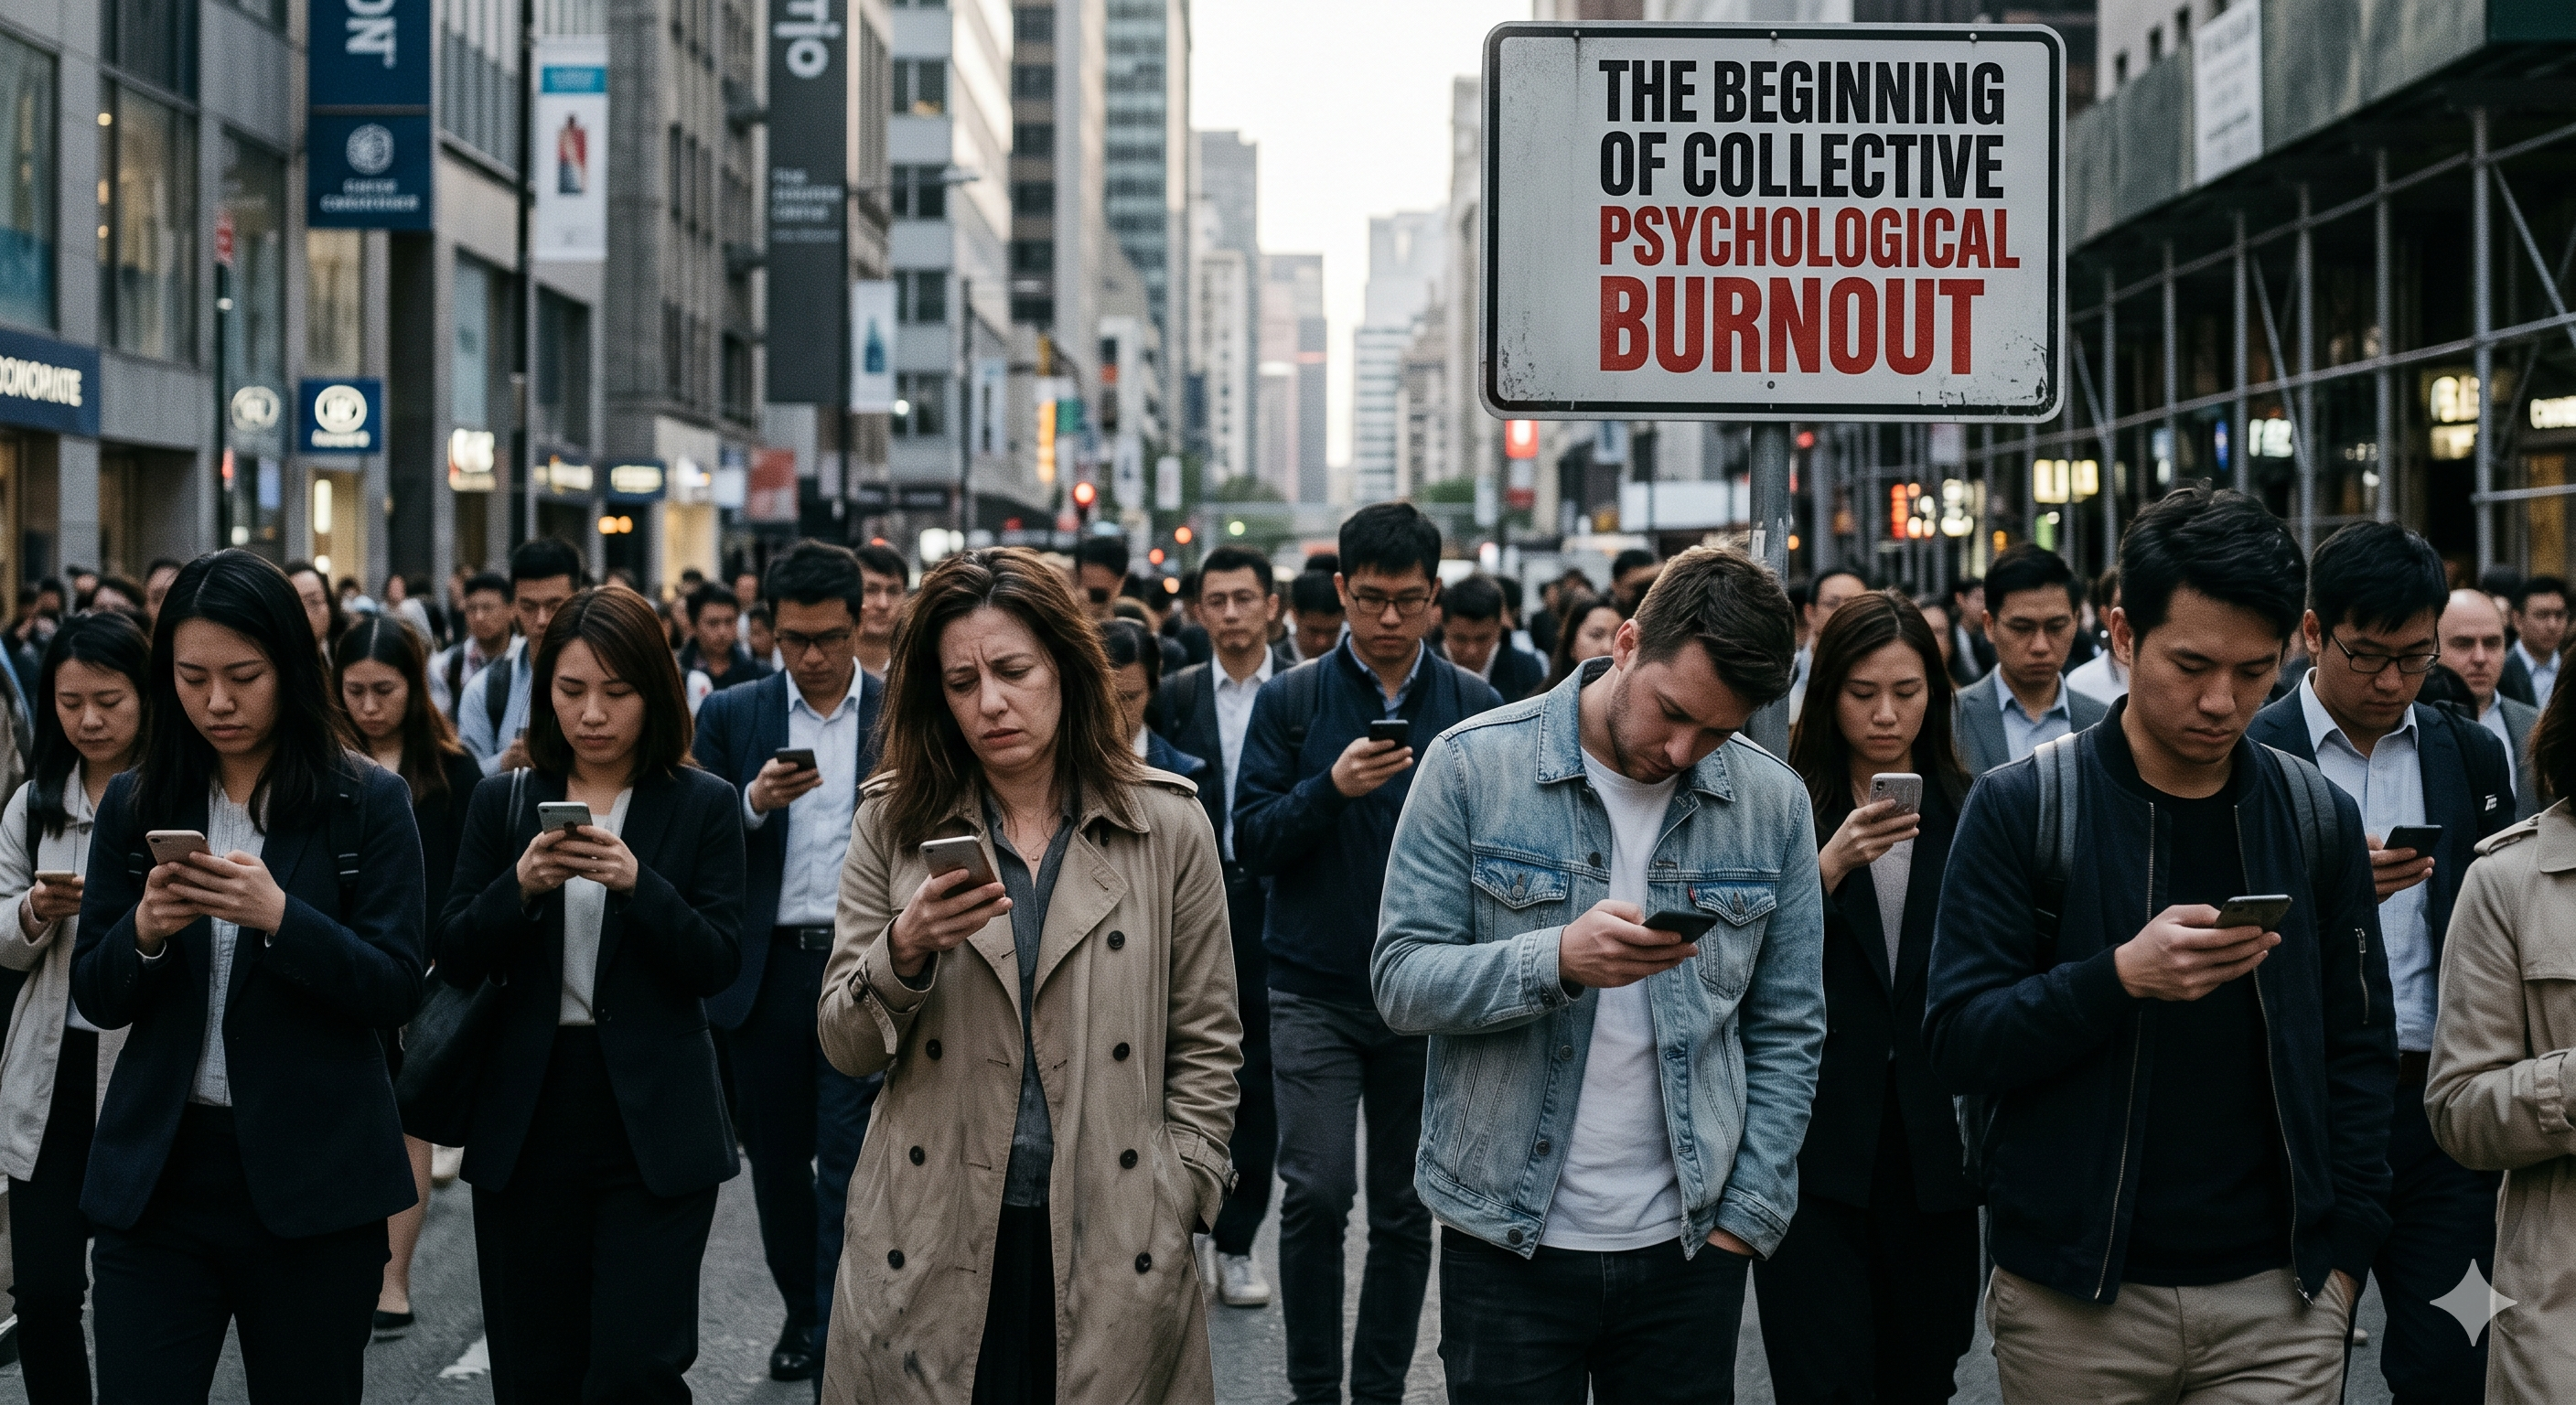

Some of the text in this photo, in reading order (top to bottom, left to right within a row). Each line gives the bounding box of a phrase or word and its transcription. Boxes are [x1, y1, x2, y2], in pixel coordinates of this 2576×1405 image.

[1599, 59, 2005, 125] THE BEGINNING
[1600, 131, 2004, 199] OF COLLECTIVE
[1600, 206, 2021, 269] PSYCHOLOGICAL
[1600, 275, 1985, 376] BURNOUT
